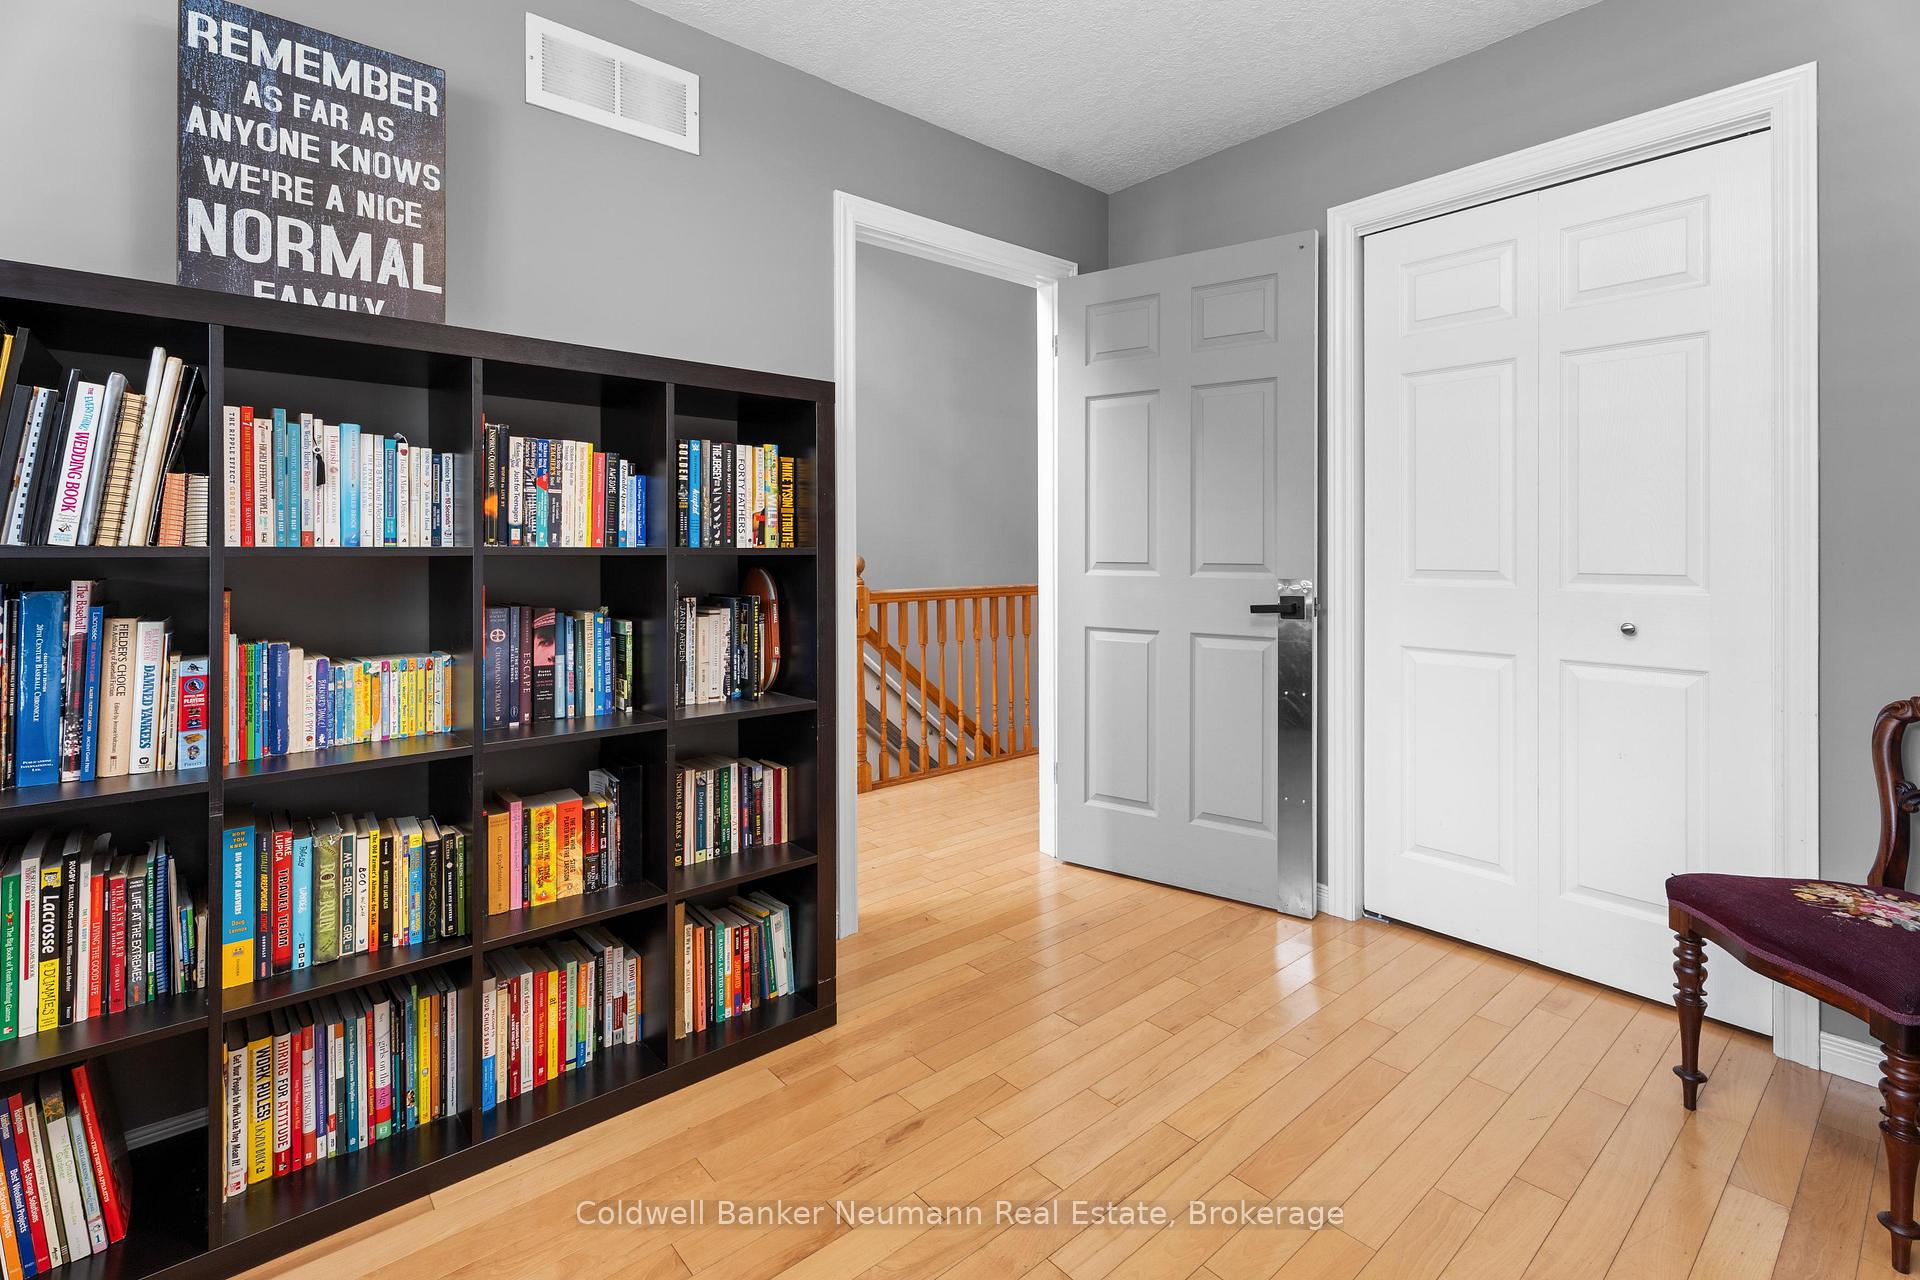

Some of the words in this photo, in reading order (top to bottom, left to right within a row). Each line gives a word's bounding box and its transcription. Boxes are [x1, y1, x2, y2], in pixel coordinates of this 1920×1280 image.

[187, 10, 438, 117] REMEMBER
[243, 80, 283, 112] AS
[293, 93, 348, 130] FAR
[360, 112, 395, 142] AS
[186, 105, 320, 164] ANYONE
[331, 140, 441, 192] KNOWS
[203, 155, 314, 206] WE'RE
[325, 184, 345, 213] A
[357, 190, 422, 229] NICE
[187, 197, 443, 294] NORMAL
[79, 396, 94, 430] EVERYTHING
[68, 431, 89, 479] WEDDING
[259, 444, 267, 463] HIGHLY
[679, 444, 688, 481] GOLDEN
[713, 445, 721, 457] THE
[259, 464, 267, 493] EFFECTIVE
[713, 457, 721, 480] JERSEY
[782, 463, 793, 482] MIKE
[61, 481, 77, 513] BOOK
[259, 494, 267, 514] PEOPLE
[782, 484, 793, 508] TYSON
[77, 585, 88, 598] The
[75, 600, 87, 629] Baseball
[118, 624, 128, 662] FIELDER'S
[116, 664, 126, 696] CHOICE
[141, 665, 155, 706] DAMNED
[139, 708, 152, 748] YANKEES
[275, 835, 283, 861] LUPICA
[284, 838, 292, 856] MIKE
[344, 853, 352, 868] ME
[278, 868, 288, 911] TRAVEL
[344, 876, 352, 898] EARL
[132, 892, 141, 910] LIFE
[42, 896, 58, 954] Lacrosse
[132, 912, 141, 920] AT
[92, 922, 100, 944] LIVING
[132, 922, 141, 938] THE
[278, 916, 288, 947] TEAM
[343, 925, 352, 944] GIRL
[92, 946, 100, 960] THE
[132, 940, 141, 982] EXTREMES
[91, 961, 99, 980] GOOD
[42, 969, 56, 1015] DUMMIES
[91, 982, 99, 995] LIFE
[233, 1055, 241, 1063] Get
[278, 1040, 288, 1075] HIRING
[378, 1041, 388, 1059] girls
[233, 1064, 241, 1076] Your
[256, 1046, 270, 1080] WORK
[381, 1061, 387, 1072] on
[232, 1078, 241, 1095] People
[278, 1079, 288, 1097] FOR
[381, 1074, 389, 1086] the
[256, 1083, 270, 1122] RULES!
[379, 1088, 388, 1107] edge
[278, 1101, 288, 1148] ATTITUDE
[231, 1130, 240, 1143] They
[10, 1168, 18, 1182] Best
[22, 1159, 30, 1172] Best
[13, 1182, 23, 1209] Weekend
[25, 1173, 34, 1196] Storage
[30, 1196, 39, 1223] Solutions
[17, 1210, 27, 1233] Projects
